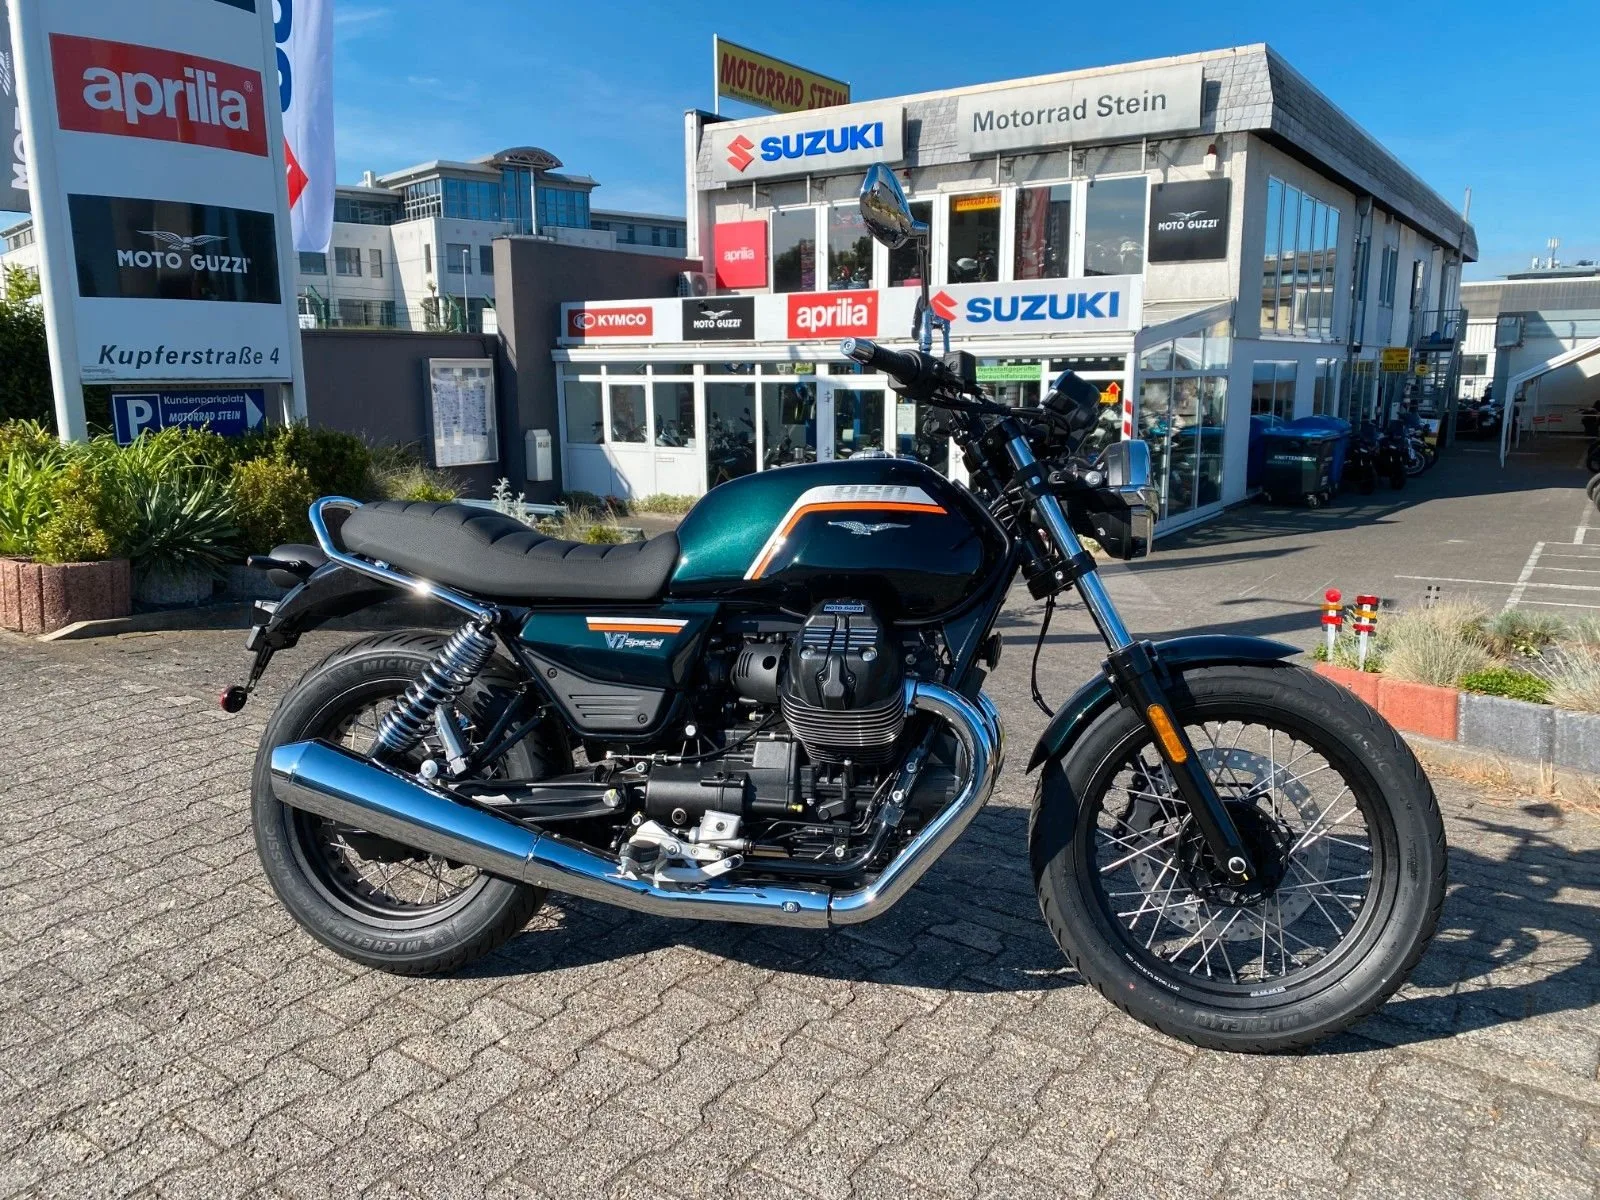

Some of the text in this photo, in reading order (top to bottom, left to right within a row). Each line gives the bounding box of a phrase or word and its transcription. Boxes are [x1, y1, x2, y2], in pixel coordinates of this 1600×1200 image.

[721, 53, 804, 107] MOTORRAD
[973, 90, 1167, 132] Motorrad Stein
[761, 122, 883, 161] SUZUKI
[1158, 218, 1217, 231] MOTO GUZZI
[117, 249, 248, 274] MOTO GUZZI
[724, 247, 754, 263] aprilia
[598, 313, 646, 326] KYMCO
[796, 298, 868, 332] aprilia
[966, 291, 1120, 323] SUZUKI
[693, 318, 741, 328] MOTO GUZZI
[98, 344, 280, 369] Kupferstraße 4
[163, 394, 244, 406] Kundenparkplatz
[127, 400, 153, 443] P
[169, 411, 241, 423] MOTORRAD STEIN
[625, 637, 665, 648] Special
